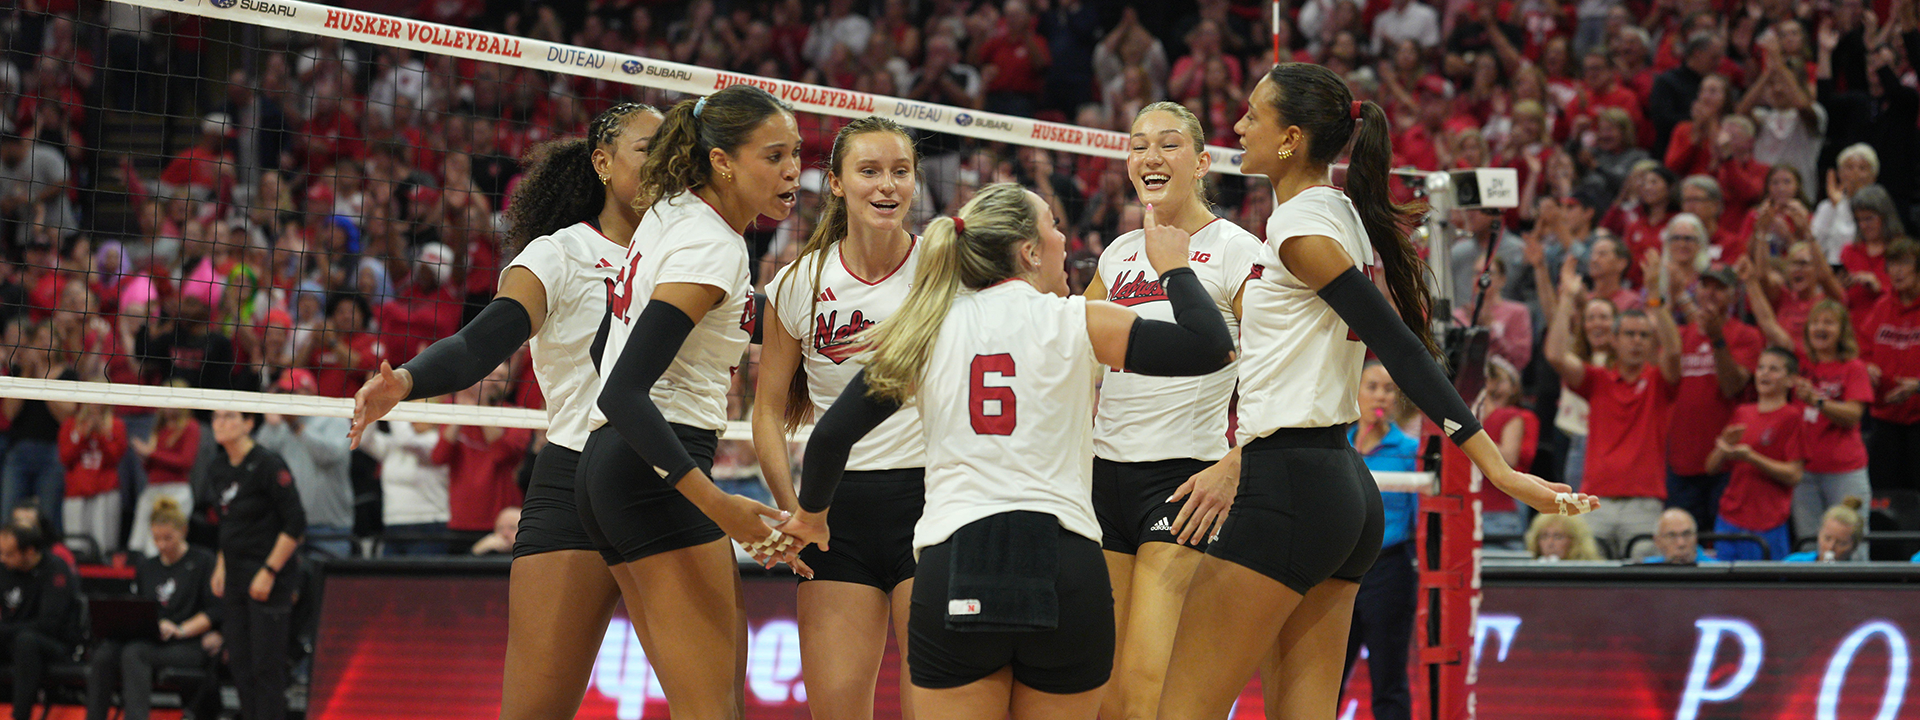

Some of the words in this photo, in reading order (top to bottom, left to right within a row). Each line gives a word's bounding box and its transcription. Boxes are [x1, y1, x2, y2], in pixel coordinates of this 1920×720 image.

[240, 0, 297, 18] SUBARU
[324, 9, 402, 39] HUSKER
[406, 22, 522, 58] VOLLEYBALL
[547, 46, 606, 69] DUTEAU
[645, 65, 693, 81] SUBARU
[781, 84, 875, 113] VOLLEYBALL
[894, 102, 942, 123] DUTEAU
[975, 117, 1014, 132] SUBARU
[1031, 123, 1083, 146] HUSKER
[1086, 131, 1130, 152] VOLLEY
[1109, 269, 1163, 301] Nebras
[969, 353, 1017, 436] 6
